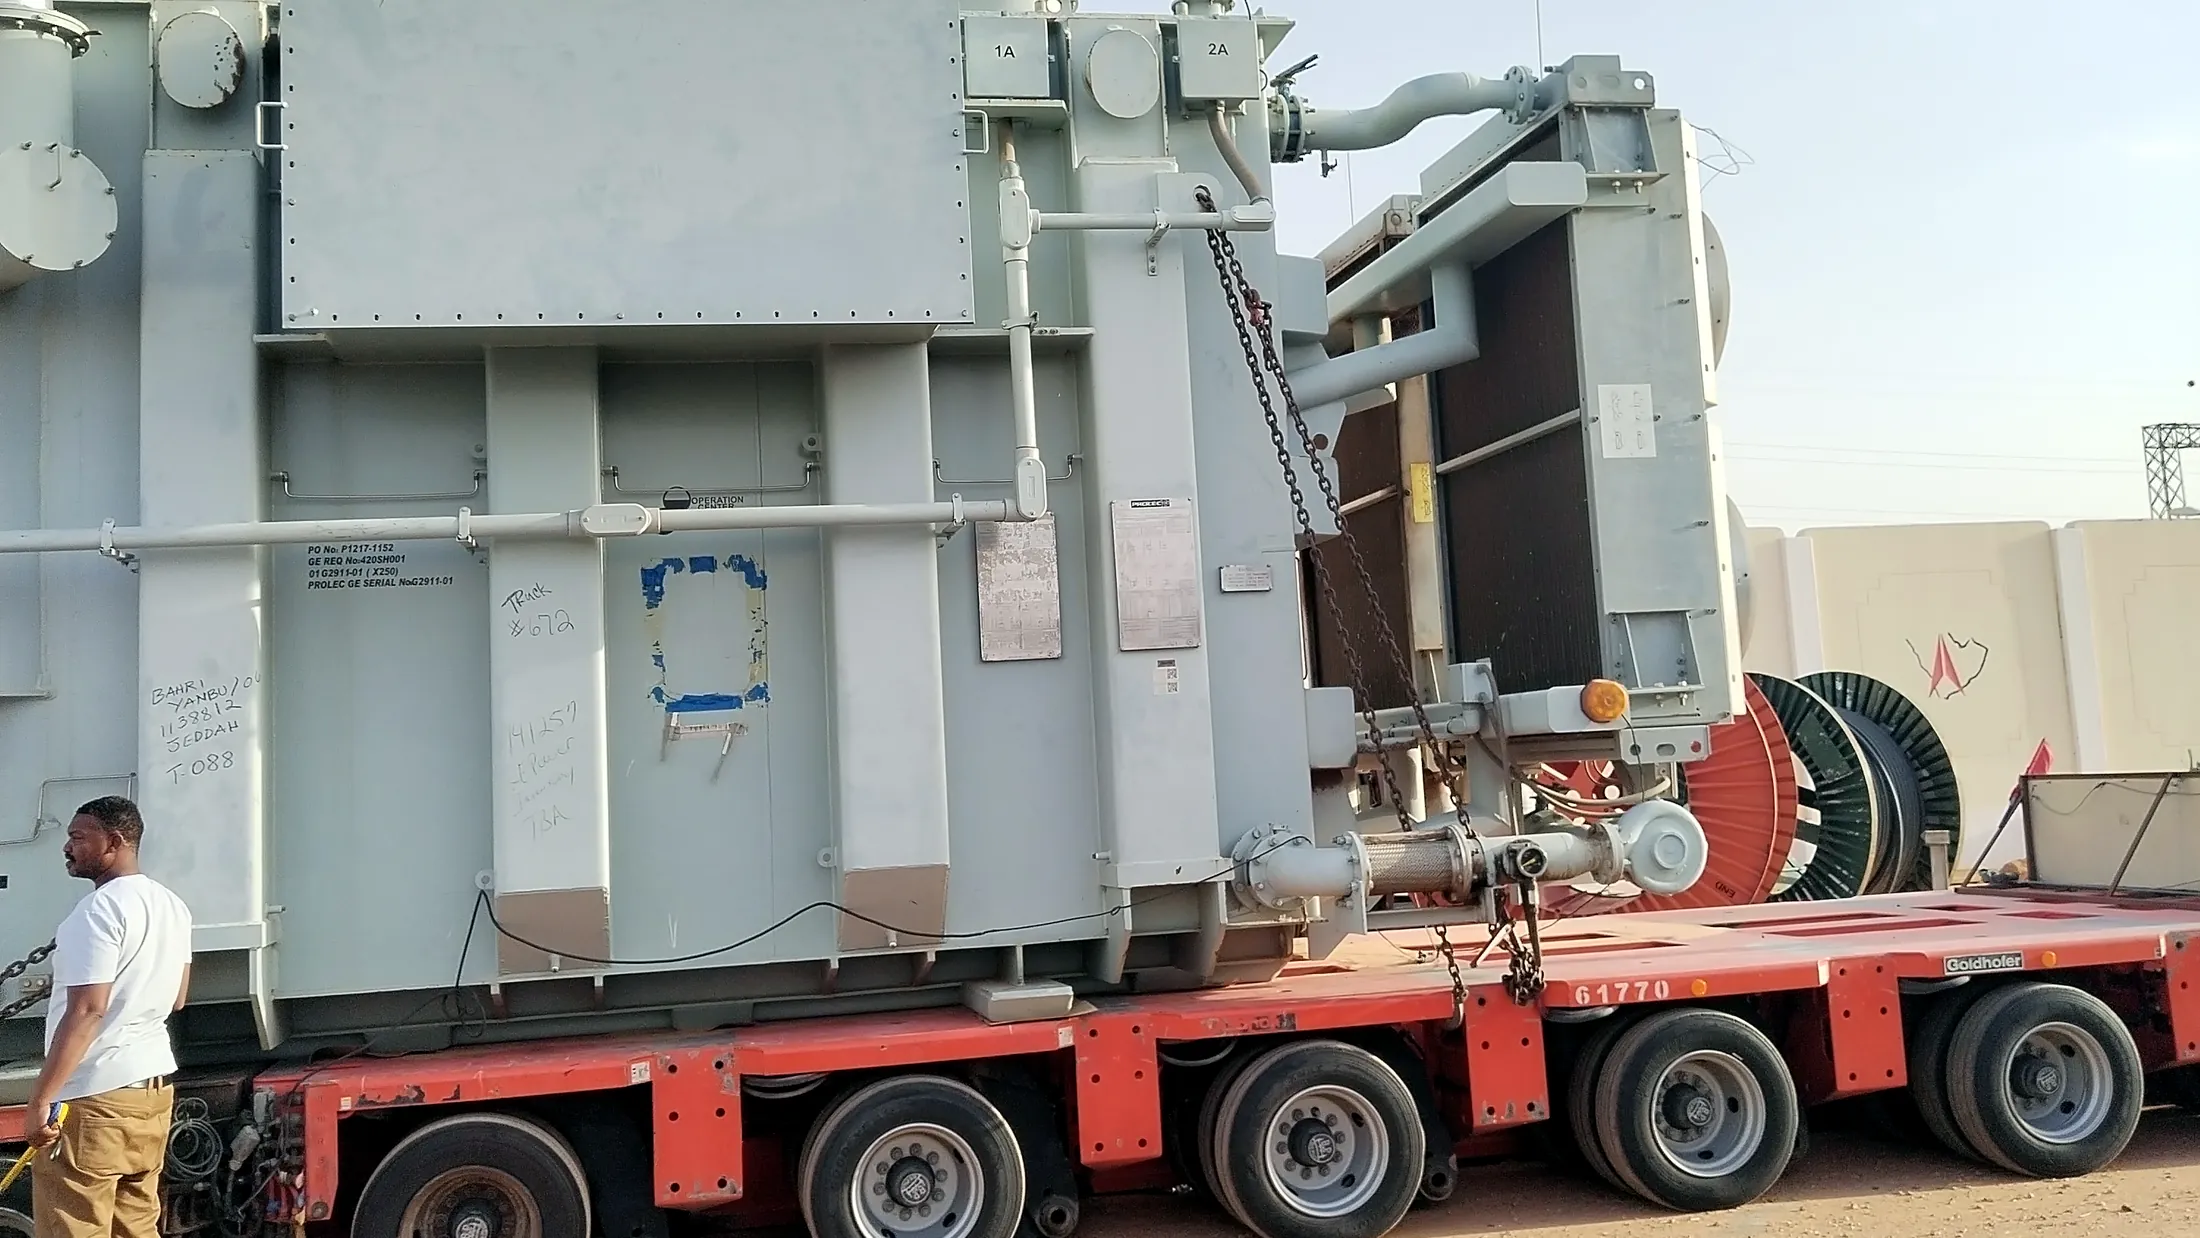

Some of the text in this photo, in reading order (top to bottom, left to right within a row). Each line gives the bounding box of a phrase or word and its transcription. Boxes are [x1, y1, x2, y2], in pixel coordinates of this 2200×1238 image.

[995, 45, 1016, 58] 1A
[1208, 43, 1229, 56] 2A
[691, 496, 744, 504] OPERATION
[308, 545, 321, 554] PO
[341, 543, 394, 553] P1217-1152
[308, 557, 321, 566] GE
[324, 557, 343, 566] REQ
[308, 580, 345, 589] PROLEC
[347, 580, 361, 588] GE
[363, 578, 396, 588] SERIAL
[509, 609, 575, 637] #672
[152, 679, 204, 705] BAHRI
[161, 699, 242, 738] 1138812
[167, 720, 239, 753] JEDDAH
[1946, 954, 2021, 972] Goldhofer
[1575, 980, 1670, 1005] 61770
